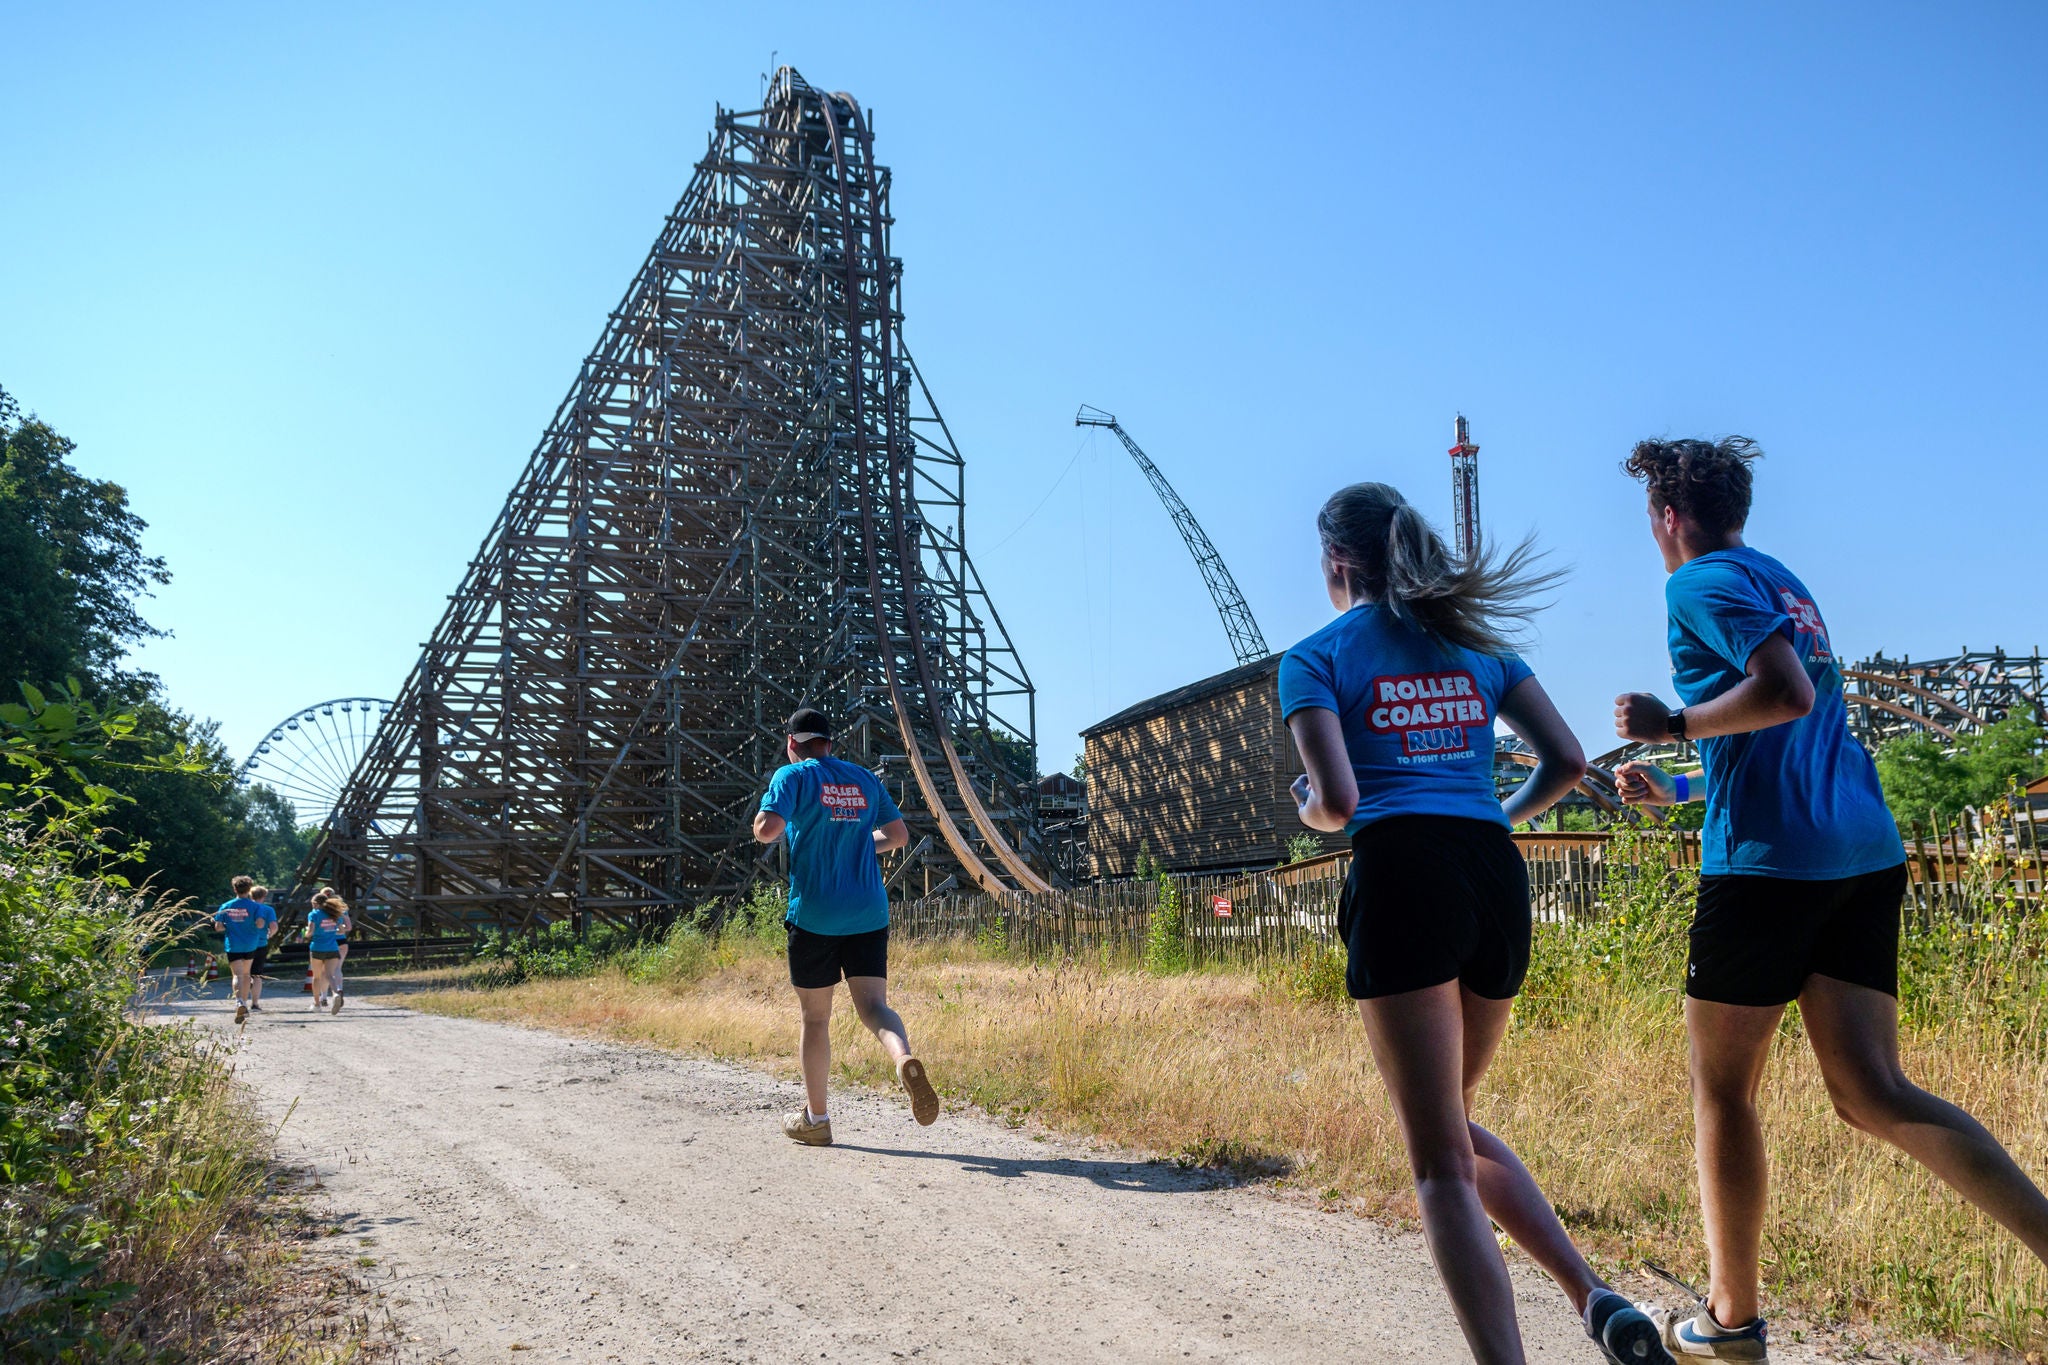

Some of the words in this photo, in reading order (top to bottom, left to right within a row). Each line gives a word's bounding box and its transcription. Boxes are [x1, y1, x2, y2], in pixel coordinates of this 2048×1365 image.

[1379, 676, 1474, 703] ROLLER
[1372, 700, 1485, 728] COASTER
[1406, 725, 1464, 752] RUN
[1396, 756, 1410, 764] TO
[1413, 754, 1439, 763] FIGHT
[1440, 750, 1476, 761] CANCER
[823, 785, 860, 796] ROLLER
[822, 795, 866, 807] COASTER
